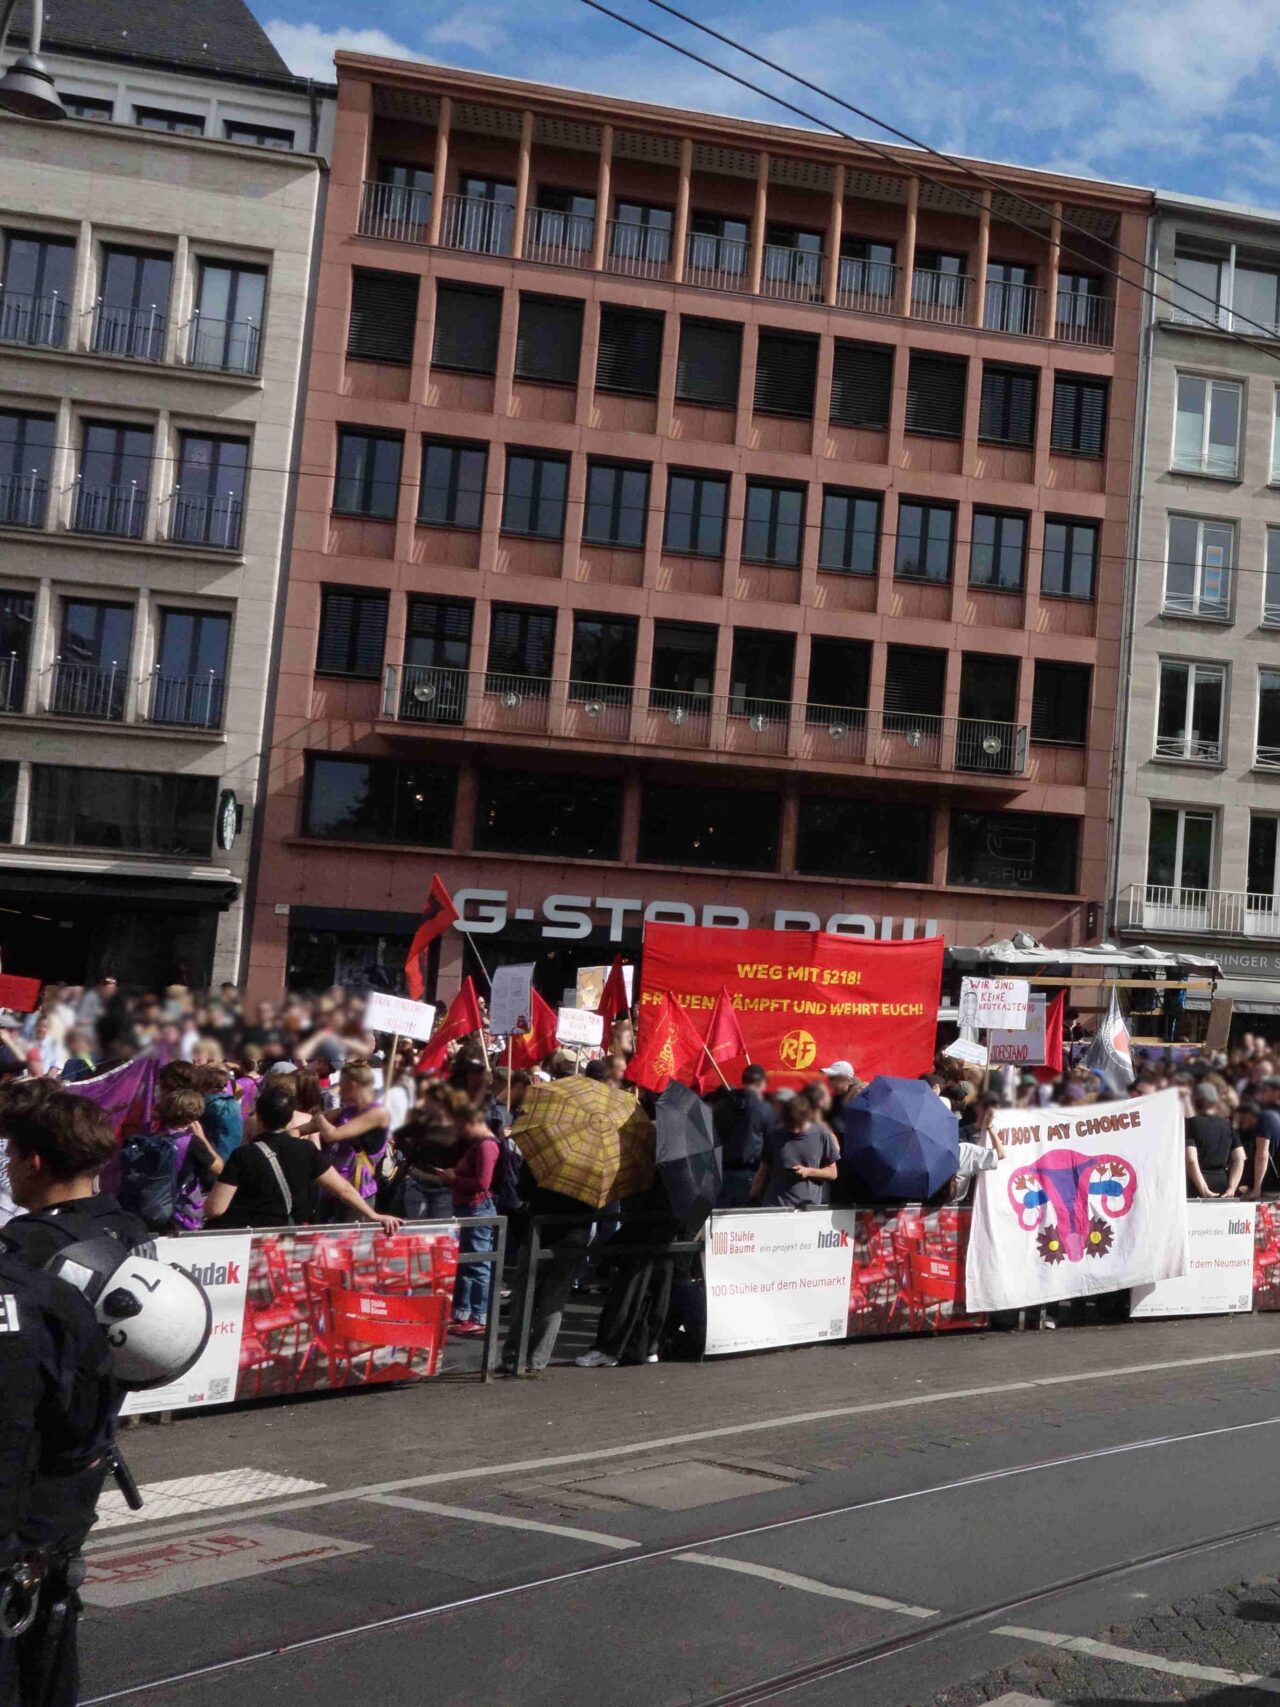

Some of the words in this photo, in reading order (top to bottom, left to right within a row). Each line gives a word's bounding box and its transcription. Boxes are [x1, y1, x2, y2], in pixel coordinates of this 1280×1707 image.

[737, 963, 783, 980] WEG
[787, 966, 820, 982] MIT
[822, 969, 861, 986] §218!
[970, 980, 989, 990] WIR
[994, 980, 1014, 990] SIND
[641, 991, 715, 1010] FRUEN
[732, 993, 791, 1012] ÄMPFT
[794, 1001, 827, 1016] UND
[830, 1002, 879, 1016] WEHRT
[881, 1003, 923, 1016] EUCH!
[1011, 1125, 1040, 1146] BODY
[1047, 1123, 1071, 1141] MY
[1075, 1111, 1141, 1137] CHOICE
[1191, 1228, 1213, 1236] projekt
[1228, 1219, 1251, 1235] hdak
[772, 1243, 798, 1253] projekt
[799, 1242, 812, 1250] des
[817, 1229, 849, 1249] hdak
[1195, 1259, 1213, 1269] dem
[1214, 1257, 1250, 1268] Neumarkt
[711, 1284, 727, 1297] 100
[729, 1282, 758, 1295] Stühle
[759, 1280, 775, 1293] auf
[777, 1279, 797, 1291] dem
[799, 1275, 847, 1289] Neumarkt
